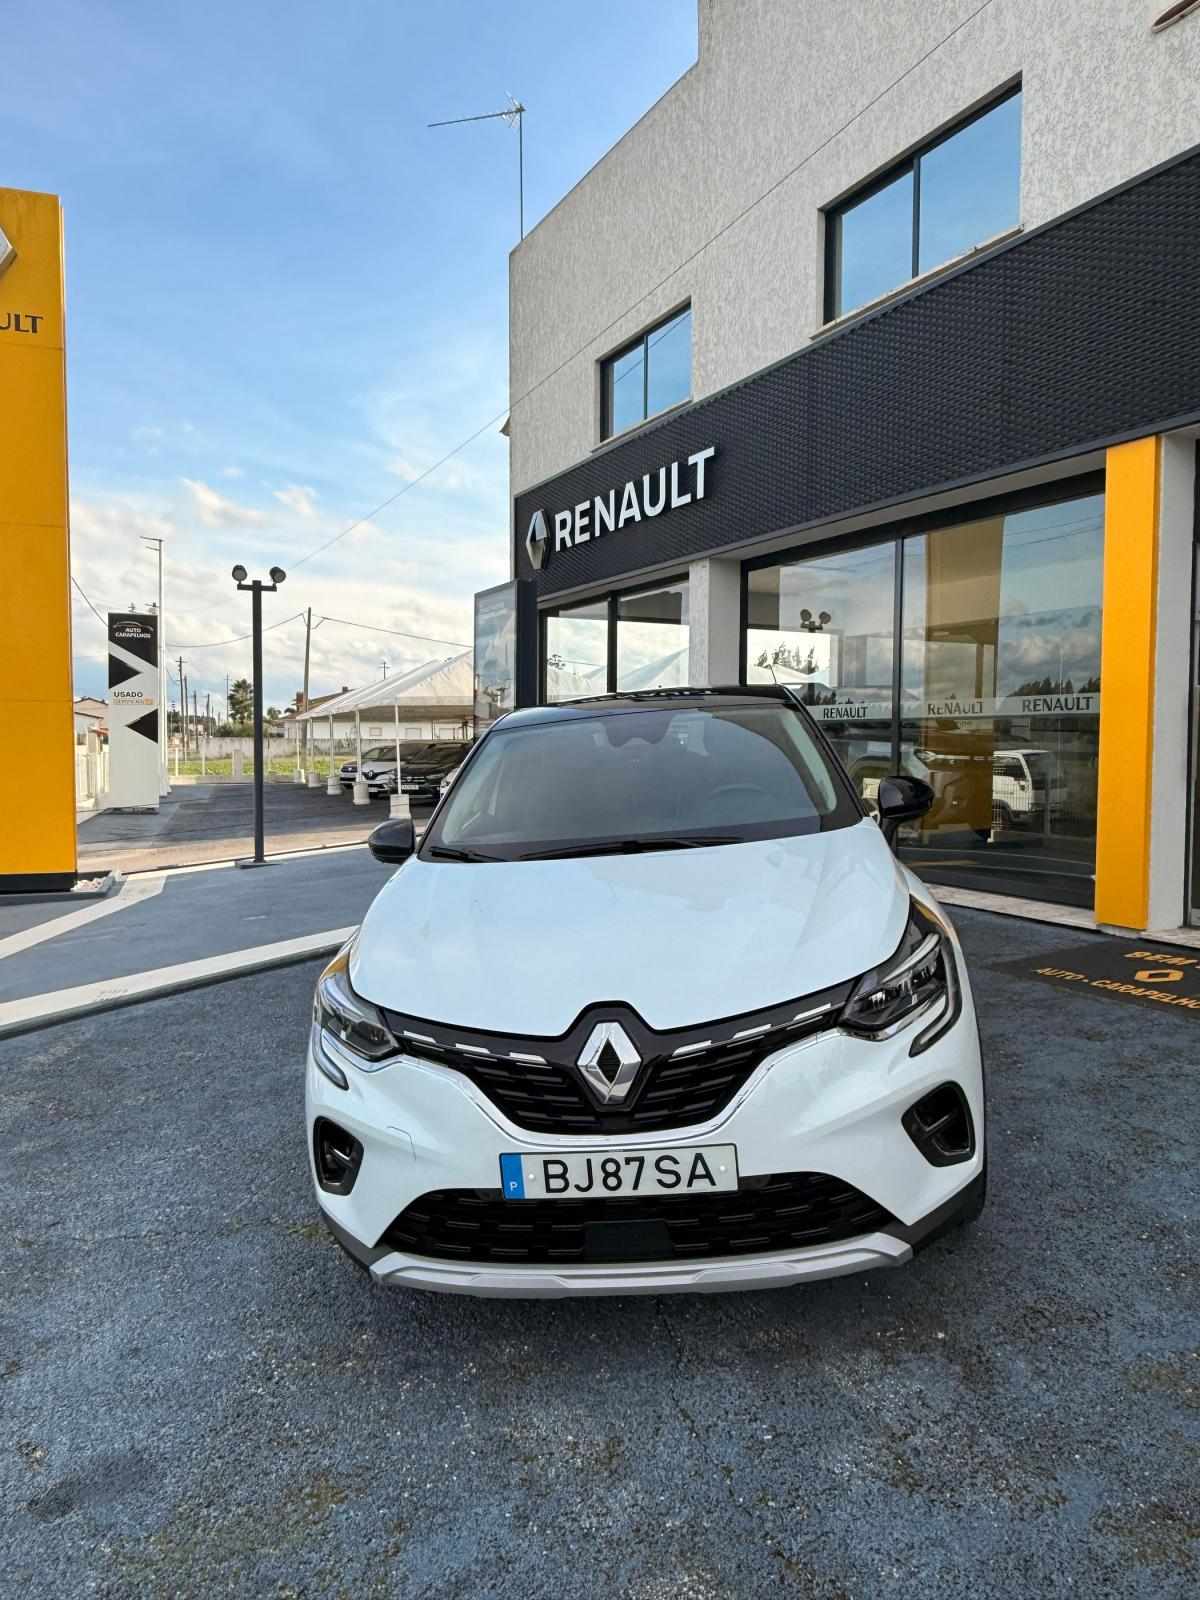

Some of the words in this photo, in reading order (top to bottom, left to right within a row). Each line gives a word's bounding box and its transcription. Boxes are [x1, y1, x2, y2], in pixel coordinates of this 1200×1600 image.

[555, 446, 715, 552] RENAULT
[927, 701, 984, 715] RENAULT
[1022, 697, 1093, 712] RENAULT
[823, 706, 868, 719] RENAULT
[510, 1182, 518, 1192] P
[543, 1153, 717, 1193] BJ87SA
